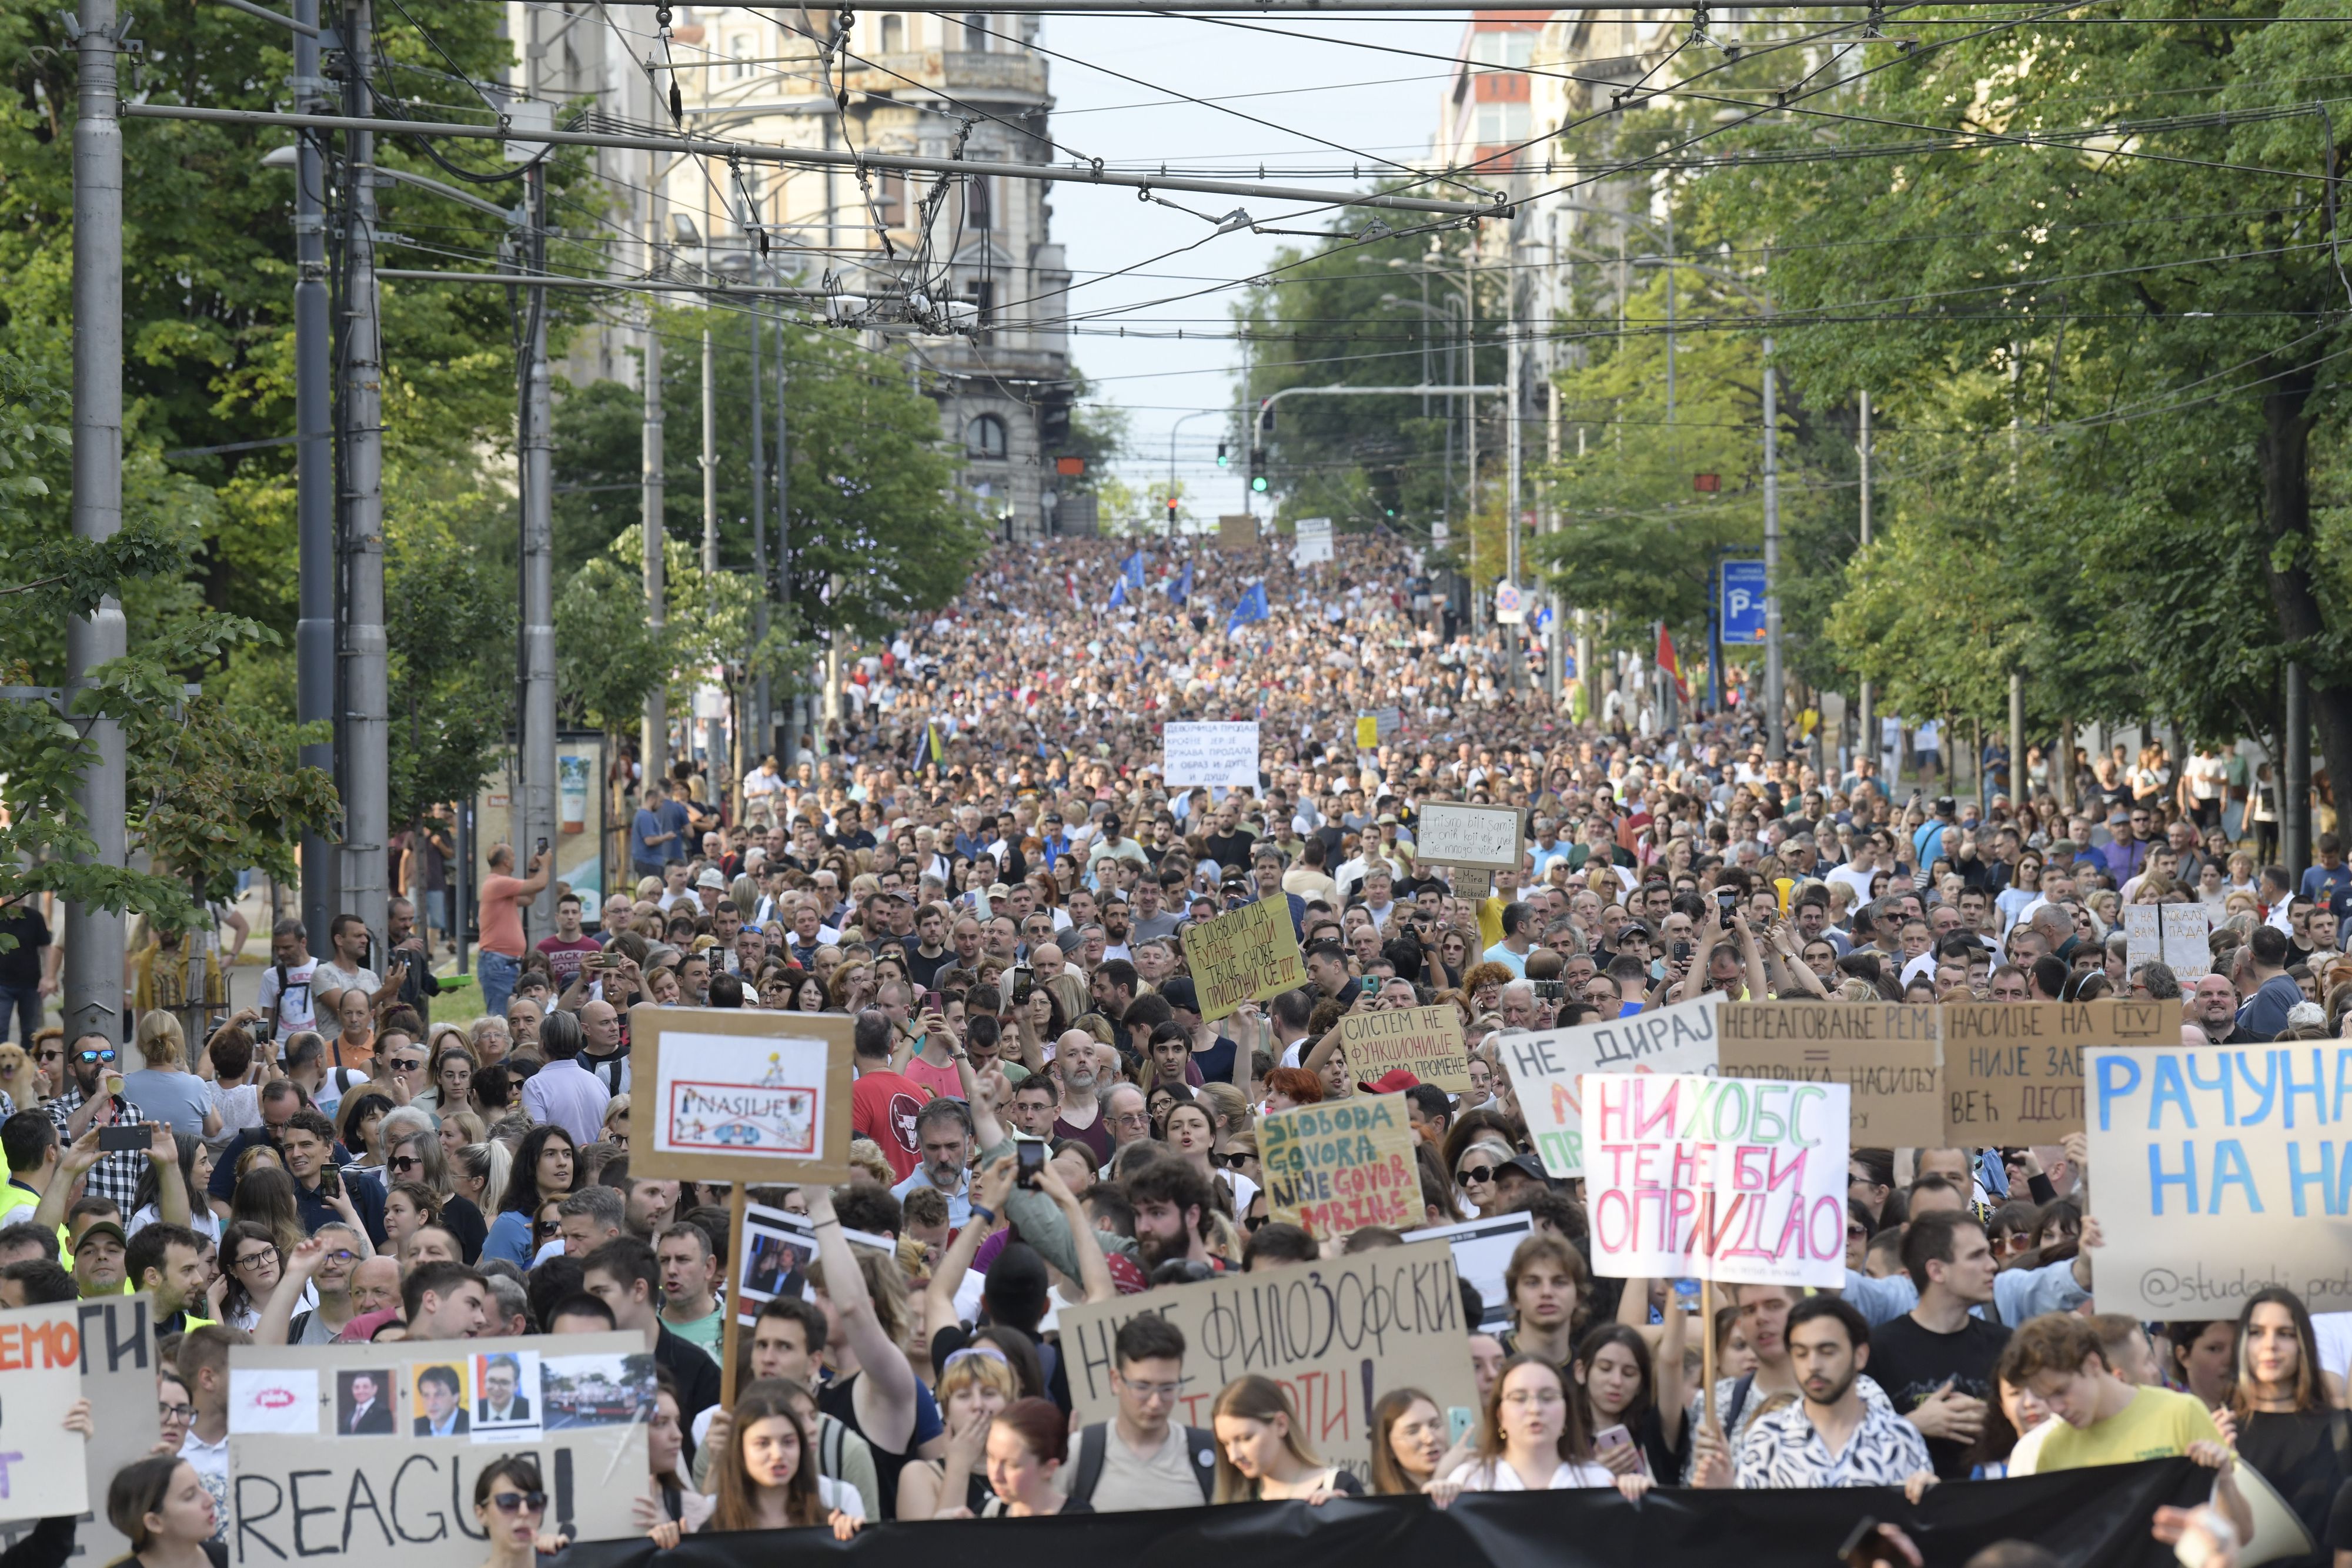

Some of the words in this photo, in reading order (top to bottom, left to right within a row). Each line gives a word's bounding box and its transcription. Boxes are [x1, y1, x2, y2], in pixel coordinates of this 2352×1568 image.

[1167, 748, 1203, 758] ДРЖАВА
[1209, 747, 1252, 757] ПРОДАЛА
[1180, 760, 1208, 770] ОБРАЗ
[1204, 773, 1230, 782] ДУШУ
[1434, 815, 1461, 827] nismo
[1468, 814, 1484, 828] bili
[1419, 830, 1432, 842] jer
[1438, 828, 1458, 840] onih
[1464, 830, 1478, 845] koji
[1481, 833, 1492, 844] vole
[1497, 837, 1514, 846] uvek
[1429, 842, 1440, 855] je
[1445, 844, 1472, 858] mnogo
[1185, 928, 1201, 951] НЕ
[1251, 901, 1268, 926] ДА
[2129, 912, 2133, 922] И
[2141, 912, 2153, 922] НА
[2163, 910, 2202, 921] ЛОКАЛУ
[2135, 927, 2156, 938] ВАМ
[2169, 925, 2204, 938] ПАДА
[1195, 937, 1236, 969] ЋУТАЊЕ
[1242, 919, 1277, 949] ГУШИ
[1205, 957, 1236, 985] ТВОЈЕ
[1243, 941, 1277, 971] СНОВЕ
[1206, 969, 1261, 1011] ПРИДРУЖИ
[1345, 1011, 1414, 1039] СИСТЕМ
[1422, 1009, 1444, 1029] НЕ
[1725, 1007, 1877, 1039] НЕРЕАГОВАЊЕ
[1952, 1006, 2043, 1038] НАСИЉЕ
[2062, 1005, 2093, 1034] НА
[2123, 1007, 2151, 1028] TV
[1351, 1034, 1455, 1065] ФУНКЦИОНИШЕ
[1512, 1039, 1565, 1076] НЕ
[1593, 1005, 1713, 1066] ДИРАЈ
[1415, 1057, 1467, 1078] ПРОМЕНЕ
[1969, 1047, 2031, 1078] НИЈЕ
[1850, 1066, 1937, 1095] НАСИЉУ
[1952, 1091, 1999, 1124] ВЕЋ
[1267, 1135, 1377, 1175] GOVORA
[1733, 1146, 1808, 1195] БИ
[1334, 1154, 1413, 1198] GOVOR
[2147, 1139, 2265, 1216] НА
[1202, 1259, 1456, 1384] ФИЛОЗОФСКИ
